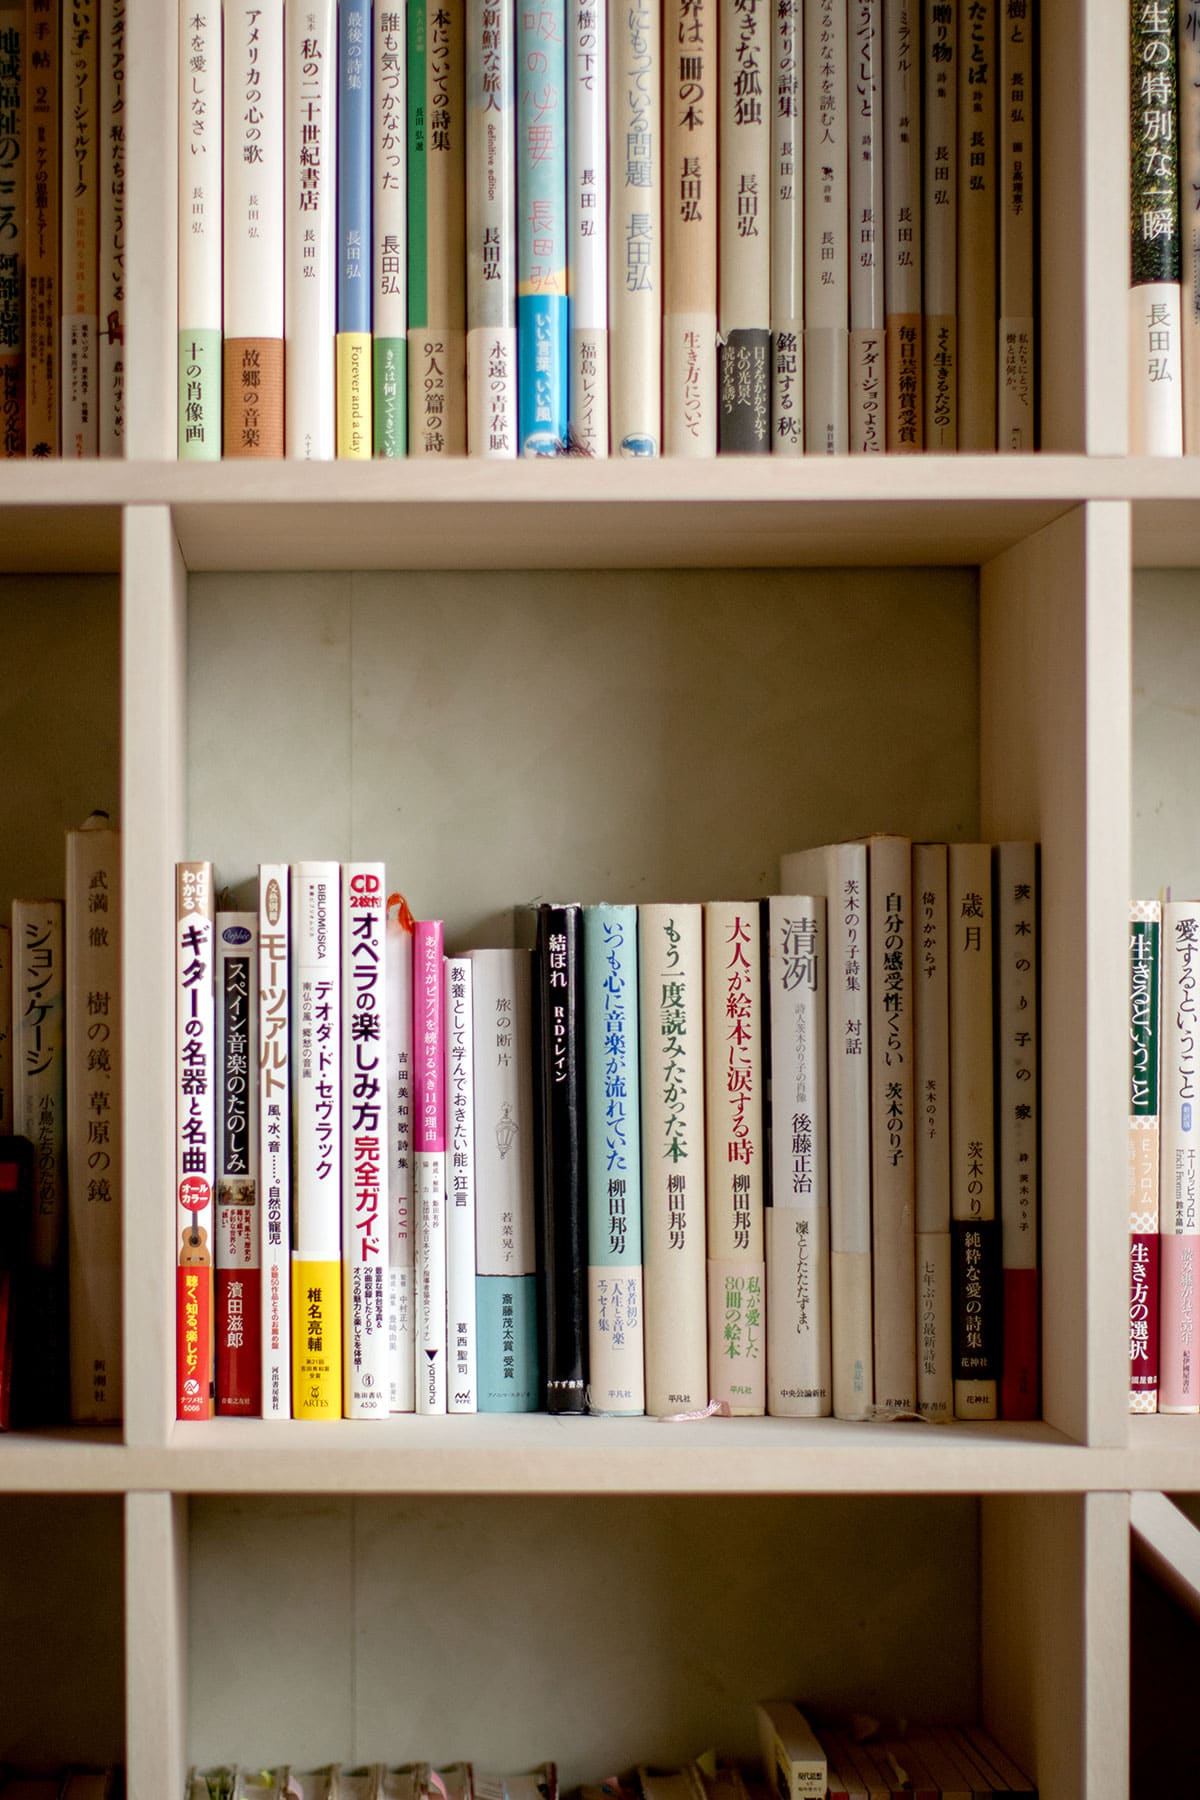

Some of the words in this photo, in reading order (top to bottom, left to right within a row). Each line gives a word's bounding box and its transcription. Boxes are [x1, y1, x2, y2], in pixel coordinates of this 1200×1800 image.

[345, 12, 362, 90] 最後の詩集
[677, 0, 704, 132] 界は一冊の本
[932, 4, 953, 64] 贈り物
[967, 1, 988, 85] たことば
[191, 14, 208, 156] 本を愛しなさい
[243, 9, 264, 164] アメリカの心の歌
[380, 14, 401, 190] 誰も気づかなかった
[431, 9, 451, 151] 本についての詩集
[521, 0, 562, 169] 吸の必要
[625, 0, 653, 189] にもっている問題
[1011, 73, 1025, 123] 長田弘
[299, 38, 322, 212] 私の二十世紀書店
[487, 125, 495, 166] definitive
[1142, 3, 1175, 241] 生の特別な一瞬
[487, 170, 495, 202] edition
[681, 157, 702, 222] 長田弘
[780, 142, 795, 201] 長田弘
[934, 146, 950, 205] 長田弘
[969, 131, 986, 192] 長田弘
[191, 187, 205, 235] 長田弘
[247, 195, 260, 239] 長田弘
[580, 170, 597, 236] 長田弘
[738, 174, 758, 238] 長田弘
[860, 209, 875, 268] 長田弘
[897, 207, 913, 267] 長田弘
[303, 230, 316, 279] 長田弘
[345, 231, 362, 280] 長田弘
[380, 235, 401, 295] 長田弘
[482, 227, 502, 280] 長田弘
[528, 201, 560, 293] 長田弘
[626, 214, 653, 292] 長田弘
[821, 232, 835, 286] 長田弘
[352, 346, 362, 393] Forever
[736, 345, 751, 406] 心の光景へ
[1146, 303, 1173, 383] 長田弘
[185, 343, 206, 444] 十の肖像画
[241, 350, 262, 448] 故郷の音楽
[352, 395, 363, 418] and
[424, 343, 445, 452] 92人92篇の詩
[488, 342, 509, 451] 永遠の青春賦
[683, 332, 703, 439] 生き方について
[754, 345, 767, 441] 日々をかがやかす
[861, 340, 881, 452] アダージョのように
[897, 326, 917, 444] 毎日芸術賞受賞
[349, 431, 363, 453] day
[88, 869, 110, 947] 武満徹
[182, 870, 196, 911] わかる
[350, 874, 380, 894] CD
[960, 892, 984, 953] 歳月
[548, 932, 568, 989] 結ぼれ
[844, 879, 860, 992] 茨木のり子詩集
[921, 891, 937, 980] 倚りかからず
[25, 919, 54, 1076] ジョン・ケージ
[260, 934, 287, 1098] モーツァルト
[883, 892, 904, 1067] 自分の感受性くらい
[1014, 883, 1032, 1120] 茨木のり子の家
[1175, 918, 1200, 1100] 愛するということ
[181, 924, 210, 1175] ギターの名器と名曲
[352, 912, 382, 1132] オペラの楽しみ方
[424, 935, 438, 1143] あなたがピアノを続けるべき11の理由
[496, 997, 513, 1068] 旅の断片
[554, 1005, 568, 1083] R・D・レイン
[602, 920, 627, 1173] いつも心に音楽が流れていた
[660, 918, 689, 1164] もう一度読みたかった本
[725, 915, 755, 1166] 大人が絵本に涙する時
[845, 1018, 862, 1056] 対話
[1128, 932, 1155, 1106] 生きるということ
[86, 991, 113, 1203] 樹の鏡、草原の鏡
[227, 963, 248, 1173] スペイン音楽のたのしみ
[314, 980, 336, 1181] デオダ・ド・セヴラック
[452, 966, 470, 1208] 教養として学んでおきたい能・狂言
[397, 1052, 409, 1169] 吉田美和歌詩集
[885, 1081, 904, 1168] 茨木のり子
[925, 1079, 937, 1140] 茨木のり子
[182, 1183, 209, 1193] オール
[791, 1112, 812, 1194] 後藤正治
[967, 1141, 984, 1221] 茨木のり
[1186, 1149, 1196, 1229] エーリッヒ・フロム
[182, 1193, 208, 1204] カラー
[353, 1135, 380, 1262] 完全ガイド
[398, 1196, 408, 1240] LOVE
[502, 1212, 514, 1263] 若菜晃子
[607, 1177, 627, 1255] 柳田邦男
[667, 1173, 688, 1251] 柳田邦男
[732, 1173, 751, 1251] 柳田邦男
[226, 1280, 244, 1349] 濱田滋郎
[306, 1287, 323, 1353] 椎名亮輔
[399, 1295, 409, 1332] 中村正人
[597, 1279, 610, 1333] エッセイ集
[611, 1278, 625, 1352] 「人生と音楽」
[626, 1279, 637, 1328] 著者初の
[725, 1276, 744, 1361] 80冊の絵本
[745, 1275, 760, 1359] 私が愛した
[921, 1261, 937, 1376] 七年ぶりの最新詩集
[964, 1231, 983, 1349] 純粋な愛の詩集
[1128, 1243, 1150, 1362] 生き方の選択
[93, 1359, 107, 1402] 新潮社
[428, 1364, 437, 1405] yamaha
[456, 1322, 468, 1375] 葛西聖司
[504, 1355, 515, 1380] 受賞
[961, 1357, 988, 1367] 花神社
[303, 1400, 329, 1408] ARTES
[608, 1389, 632, 1399] 平凡社
[668, 1393, 691, 1403] 平凡社
[730, 1385, 752, 1395] 平凡社
[780, 1388, 827, 1398] 中央公論新社
